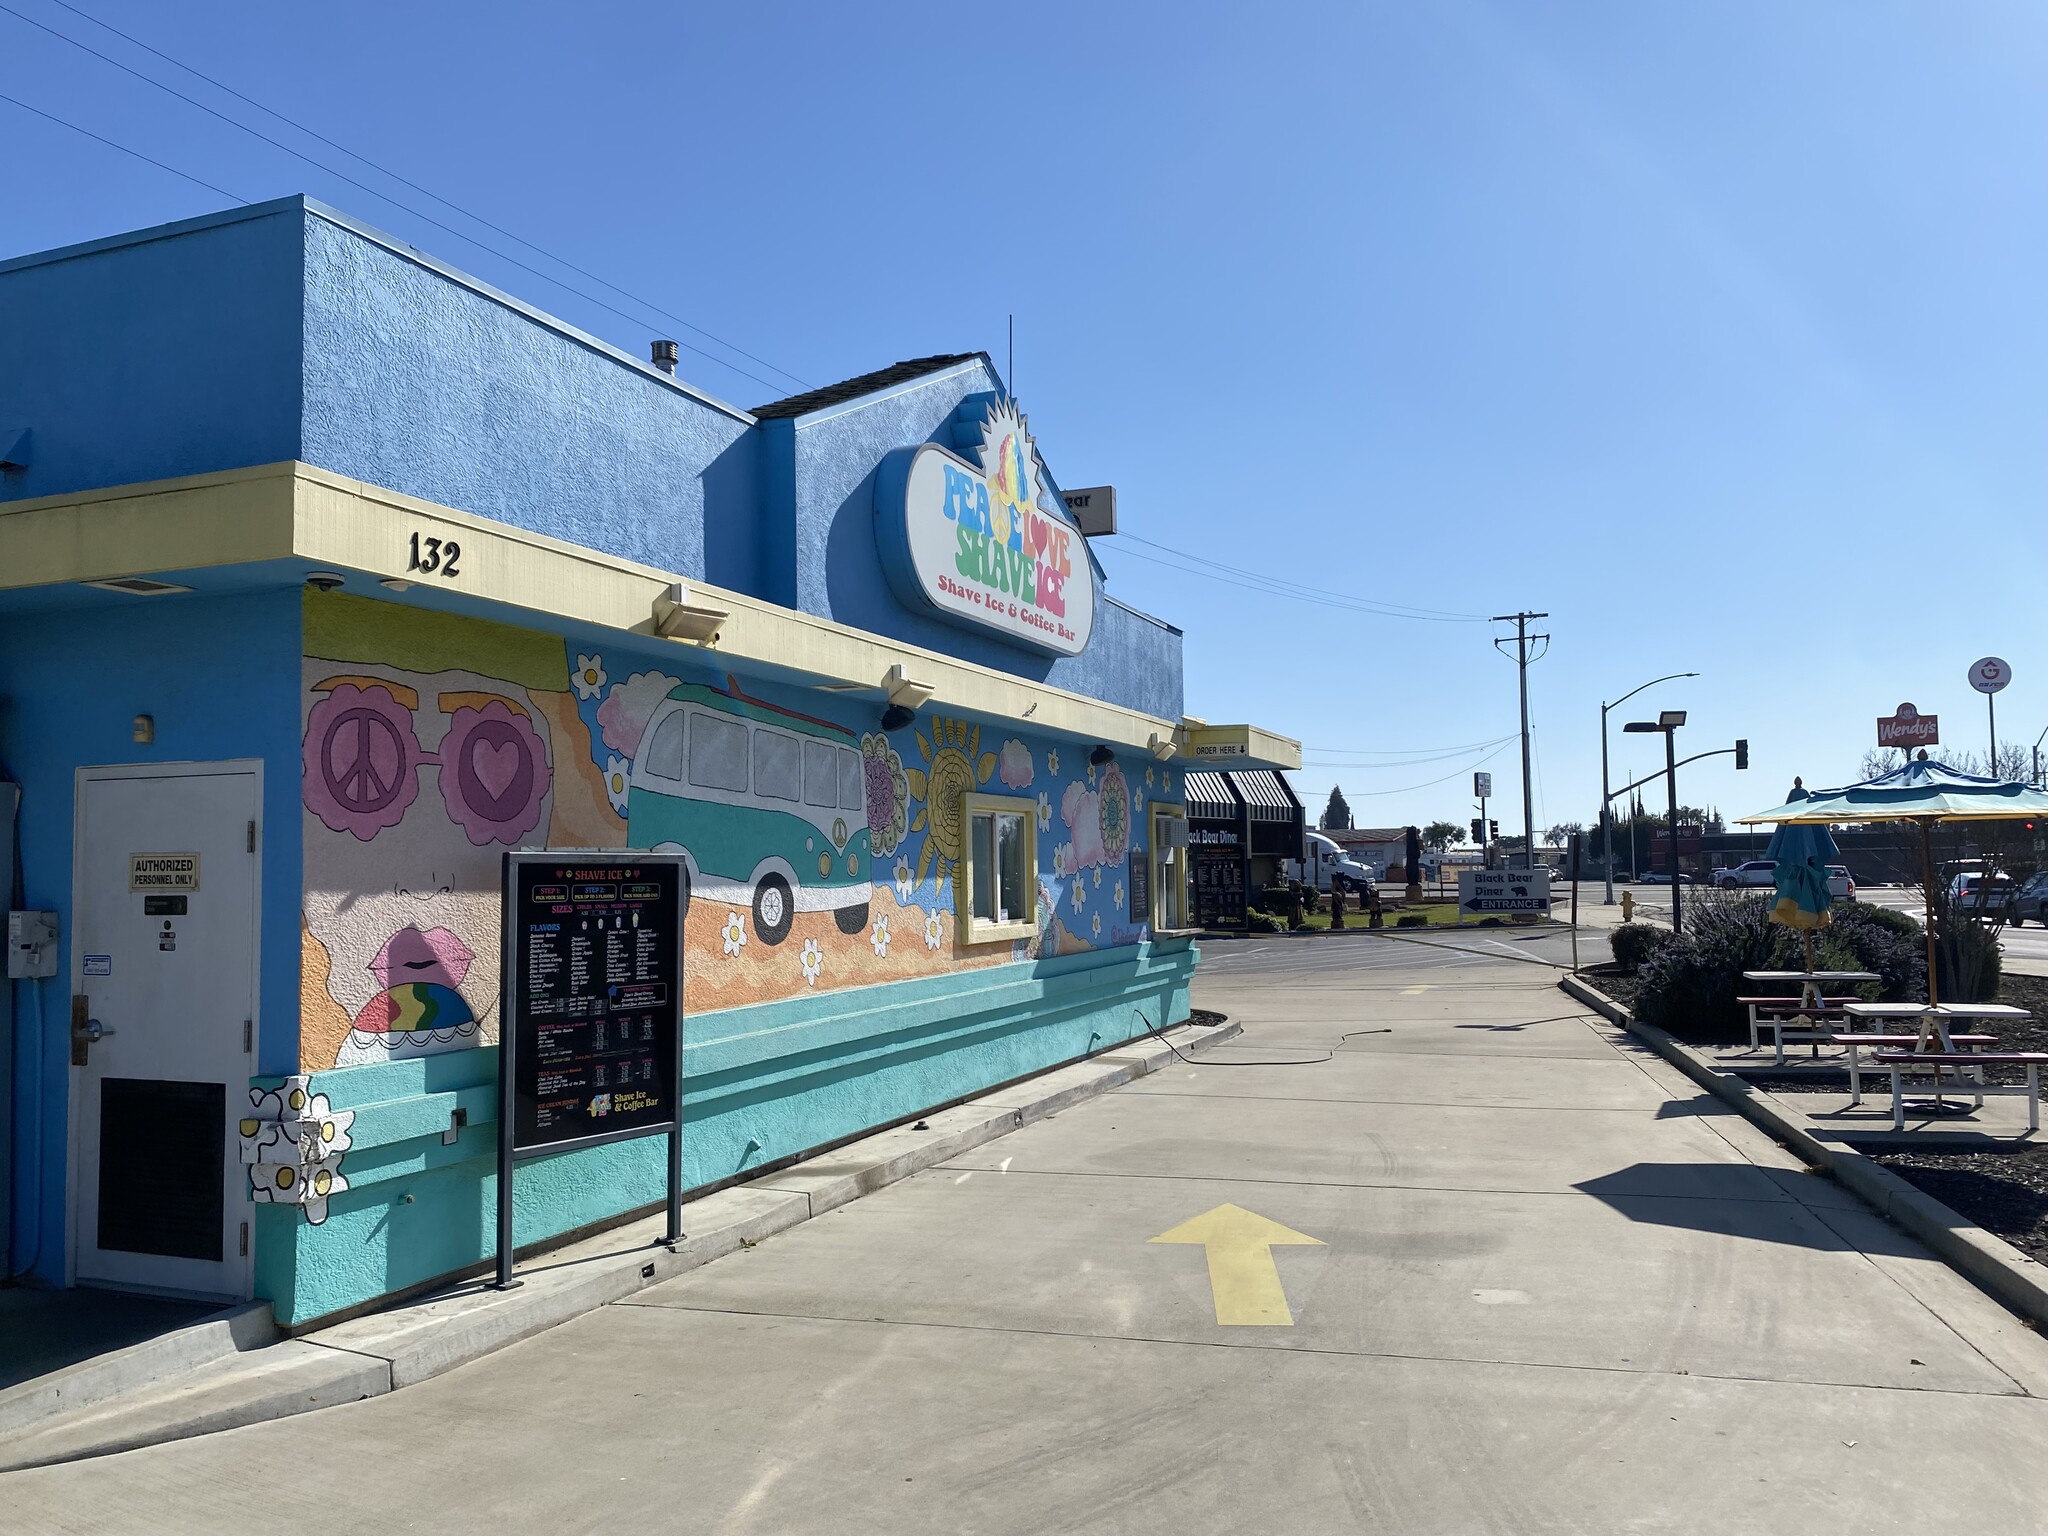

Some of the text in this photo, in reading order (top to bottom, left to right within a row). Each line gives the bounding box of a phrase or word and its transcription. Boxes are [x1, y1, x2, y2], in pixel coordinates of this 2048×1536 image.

[406, 531, 460, 578] 132
[955, 524, 1065, 618] SHAVE ICE
[938, 574, 1075, 641] Shave Ice & Coffee Bar
[1880, 719, 1936, 741] Wendy's
[1196, 745, 1236, 755] ORDER HERE
[1202, 829, 1218, 844] Bear
[1219, 830, 1238, 844] Diner
[135, 859, 193, 872] AUTHORIZED
[134, 874, 193, 885] PERSONNEL ONLY
[575, 870, 623, 880] SHAVE ICE
[1474, 874, 1533, 883] Black Bear
[1475, 887, 1504, 896] Diner
[552, 905, 573, 914] SIZES
[1481, 899, 1540, 909] ENTRANCE
[530, 923, 560, 931] FLAVORS
[538, 1023, 556, 1031] COFFEE
[614, 1091, 646, 1103] Shave Ice
[614, 1098, 658, 1112] & Coffee Bar
